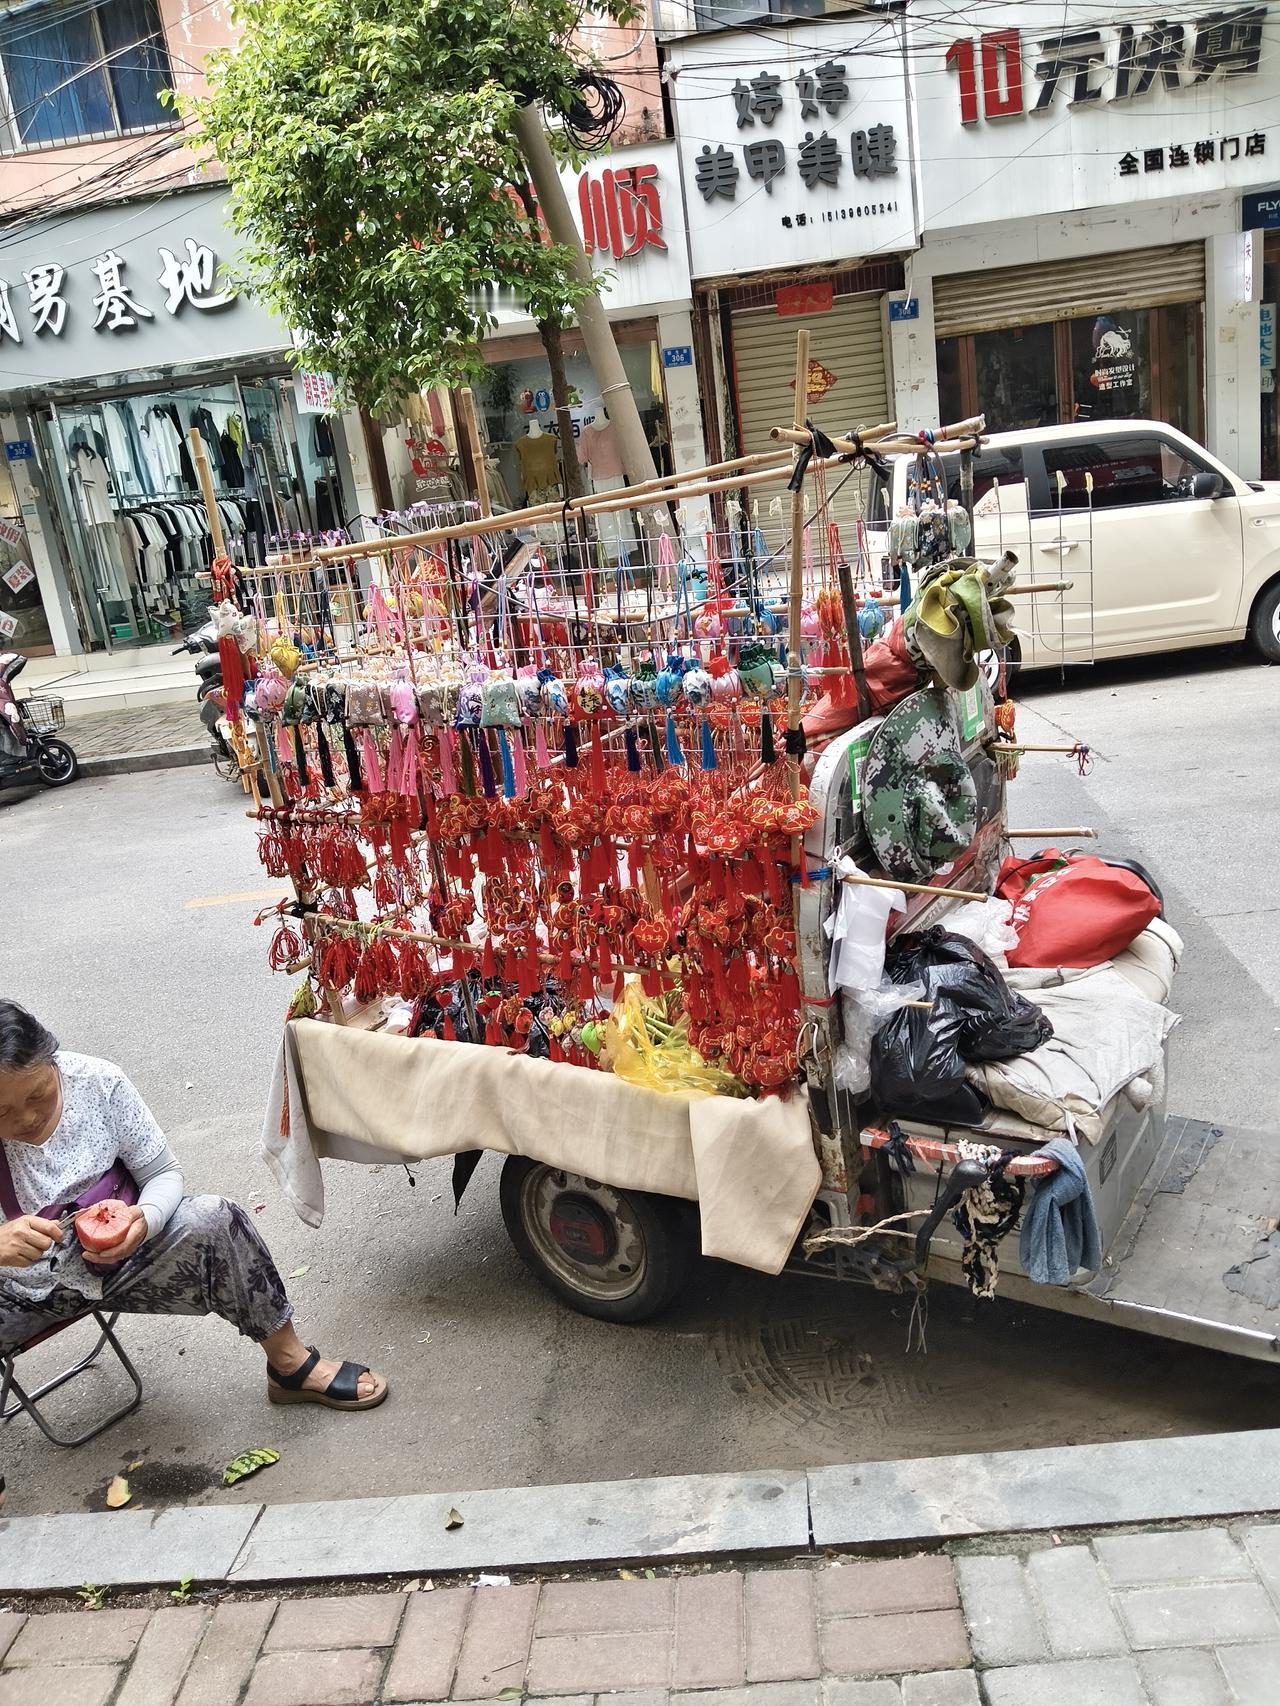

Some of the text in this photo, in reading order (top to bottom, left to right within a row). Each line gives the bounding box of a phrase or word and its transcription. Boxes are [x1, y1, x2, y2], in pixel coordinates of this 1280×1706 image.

[731, 61, 850, 129] 婷婷
[695, 123, 898, 201] 美甲美睫
[1118, 132, 1266, 176] 全国连锁门店
[1257, 200, 1280, 212] FLY
[671, 354, 685, 362] 306
